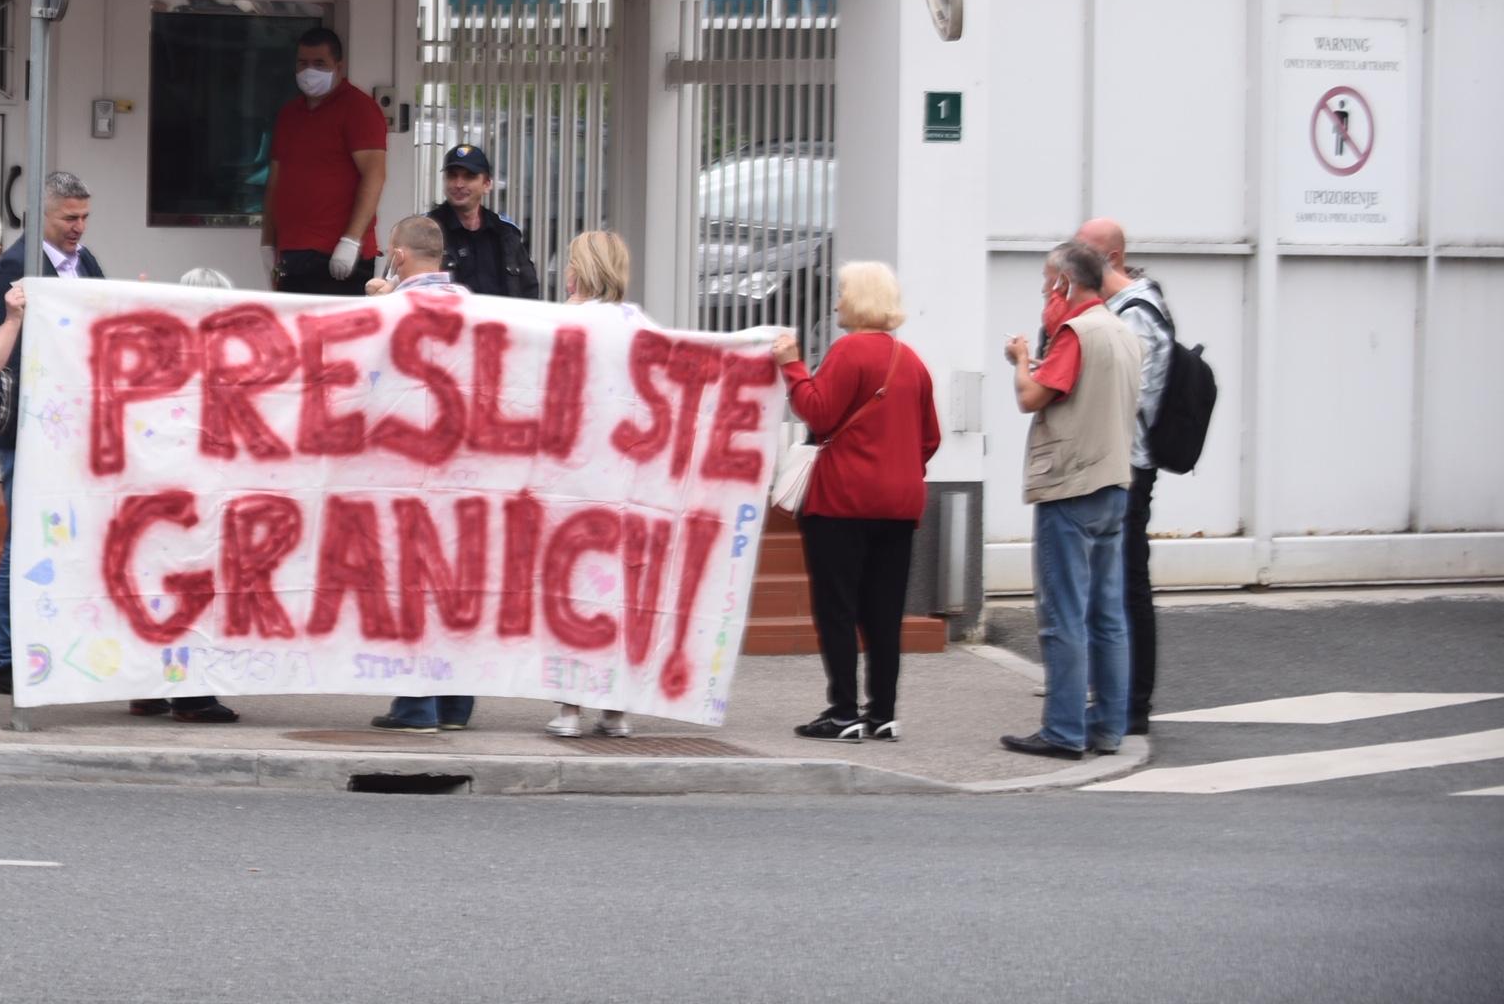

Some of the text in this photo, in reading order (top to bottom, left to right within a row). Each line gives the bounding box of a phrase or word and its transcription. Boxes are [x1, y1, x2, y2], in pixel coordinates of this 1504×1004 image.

[1314, 37, 1370, 53] WARNING
[937, 99, 946, 120] 1
[610, 330, 780, 483] STE
